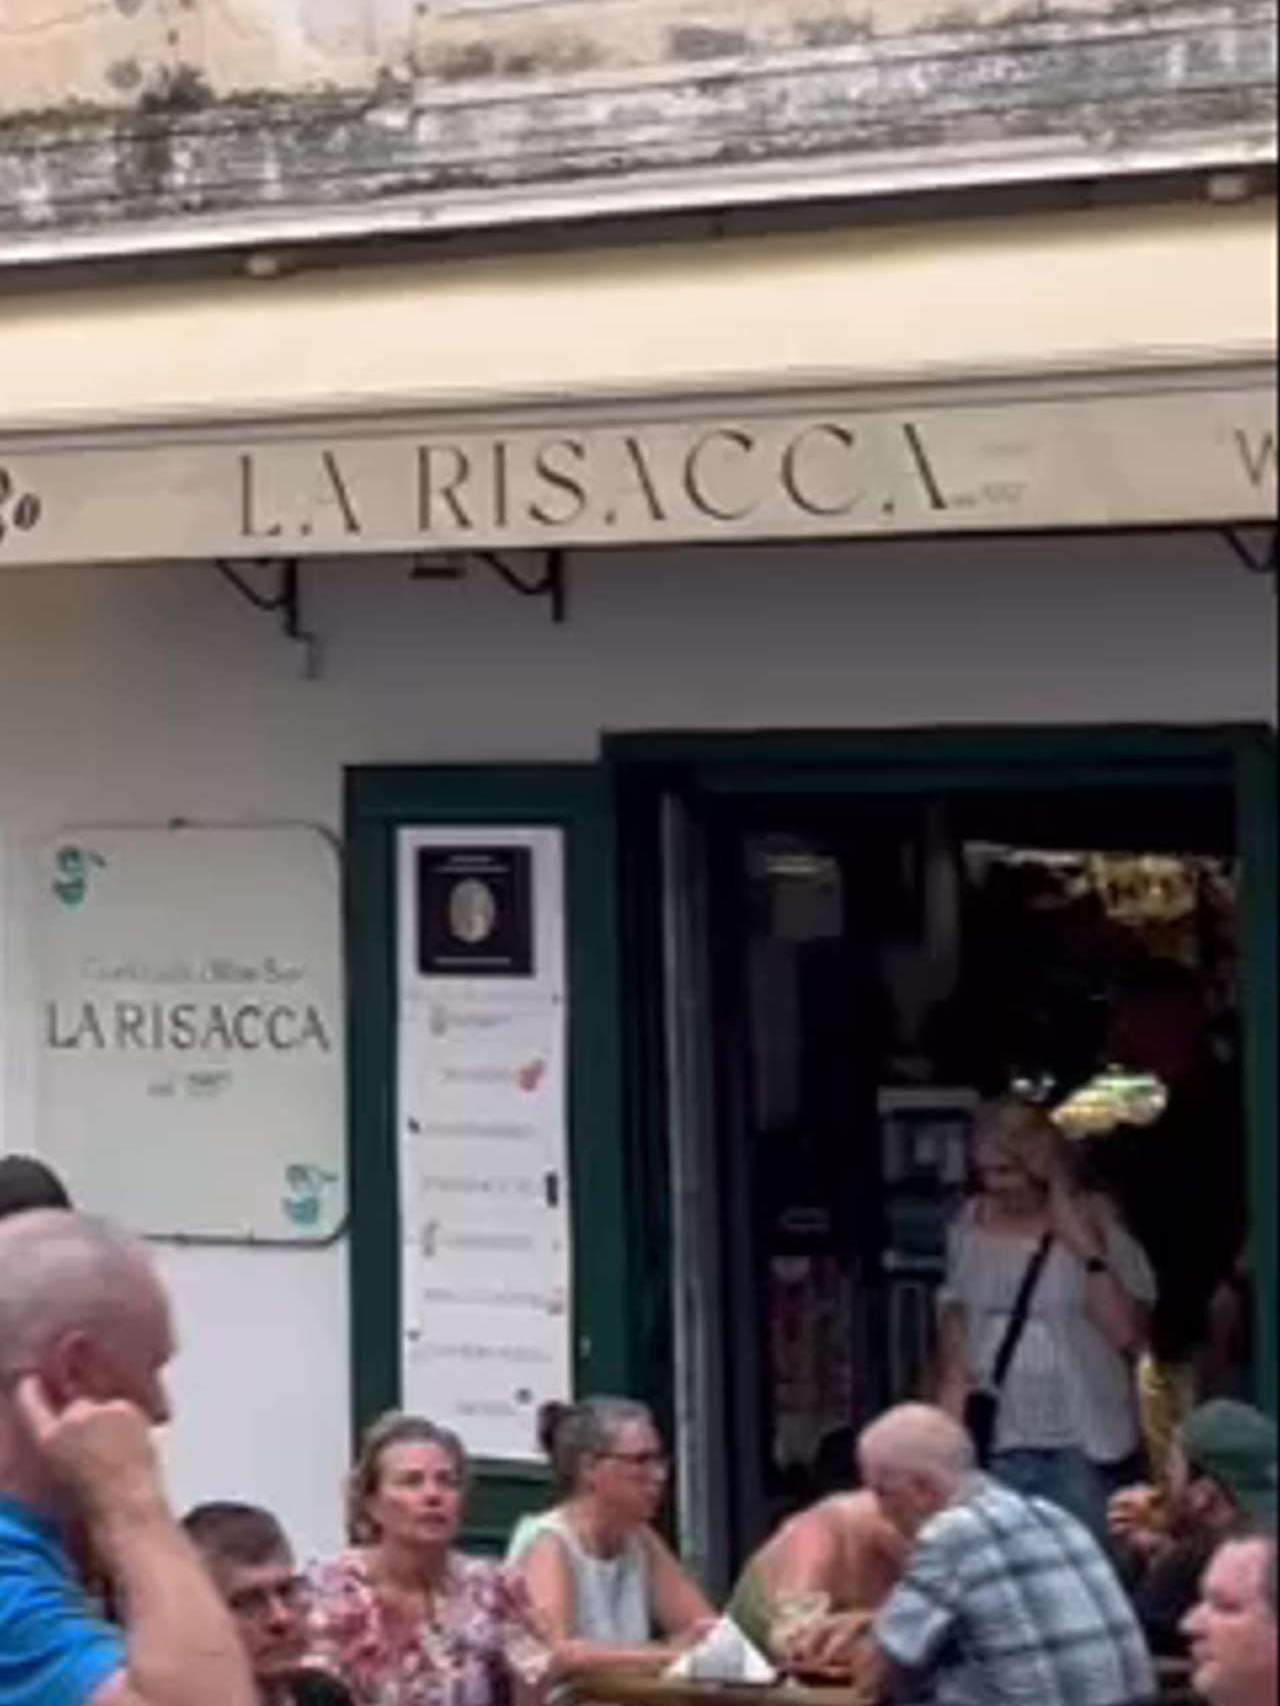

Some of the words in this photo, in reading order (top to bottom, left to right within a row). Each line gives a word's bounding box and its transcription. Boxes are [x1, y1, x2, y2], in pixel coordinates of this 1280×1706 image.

[239, 449, 362, 538] LA
[416, 420, 948, 532] RISACCA
[47, 1001, 106, 1050] LA
[114, 1000, 332, 1054] RISACCA
